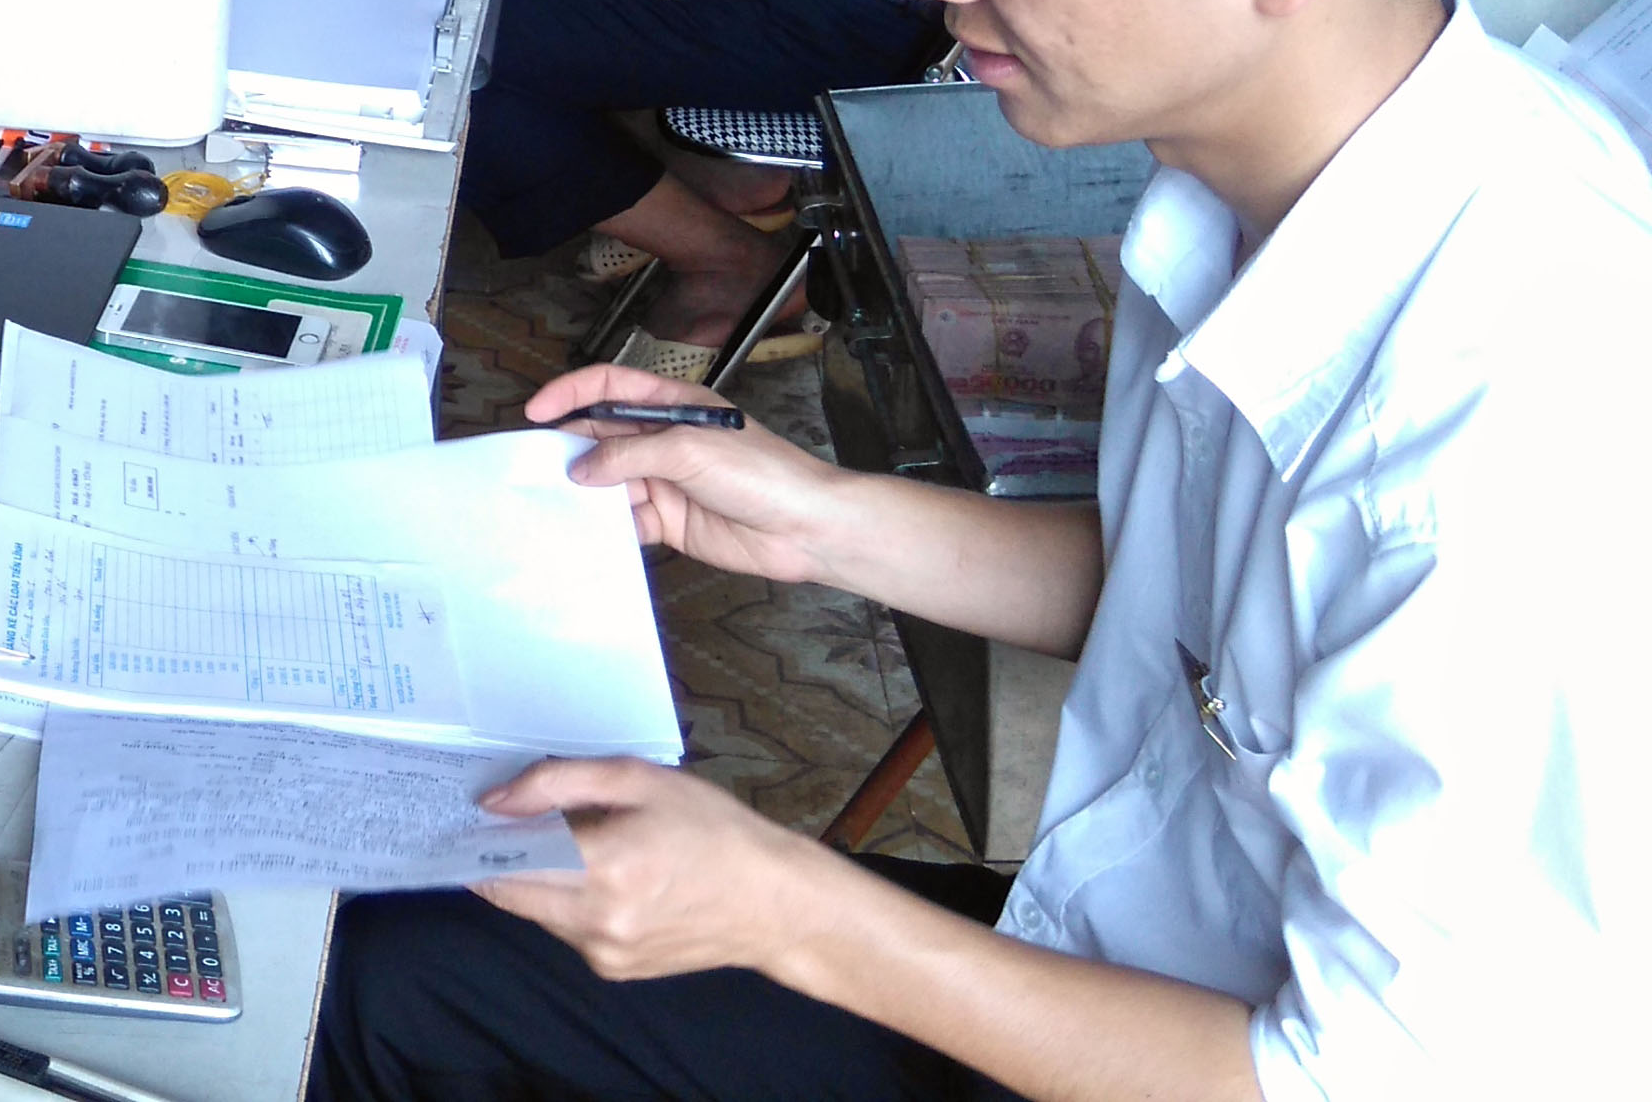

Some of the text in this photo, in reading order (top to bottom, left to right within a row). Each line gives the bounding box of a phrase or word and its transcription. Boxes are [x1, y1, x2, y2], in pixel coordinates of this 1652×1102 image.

[4, 630, 16, 650] ẢNG
[134, 904, 150, 912] 6
[165, 908, 181, 918] 3
[105, 923, 122, 932] 8
[136, 928, 152, 936] 5
[168, 931, 184, 940] 2
[139, 950, 155, 960] 4
[202, 958, 220, 967] 0
[174, 978, 189, 987] C
[208, 980, 220, 994] AC
